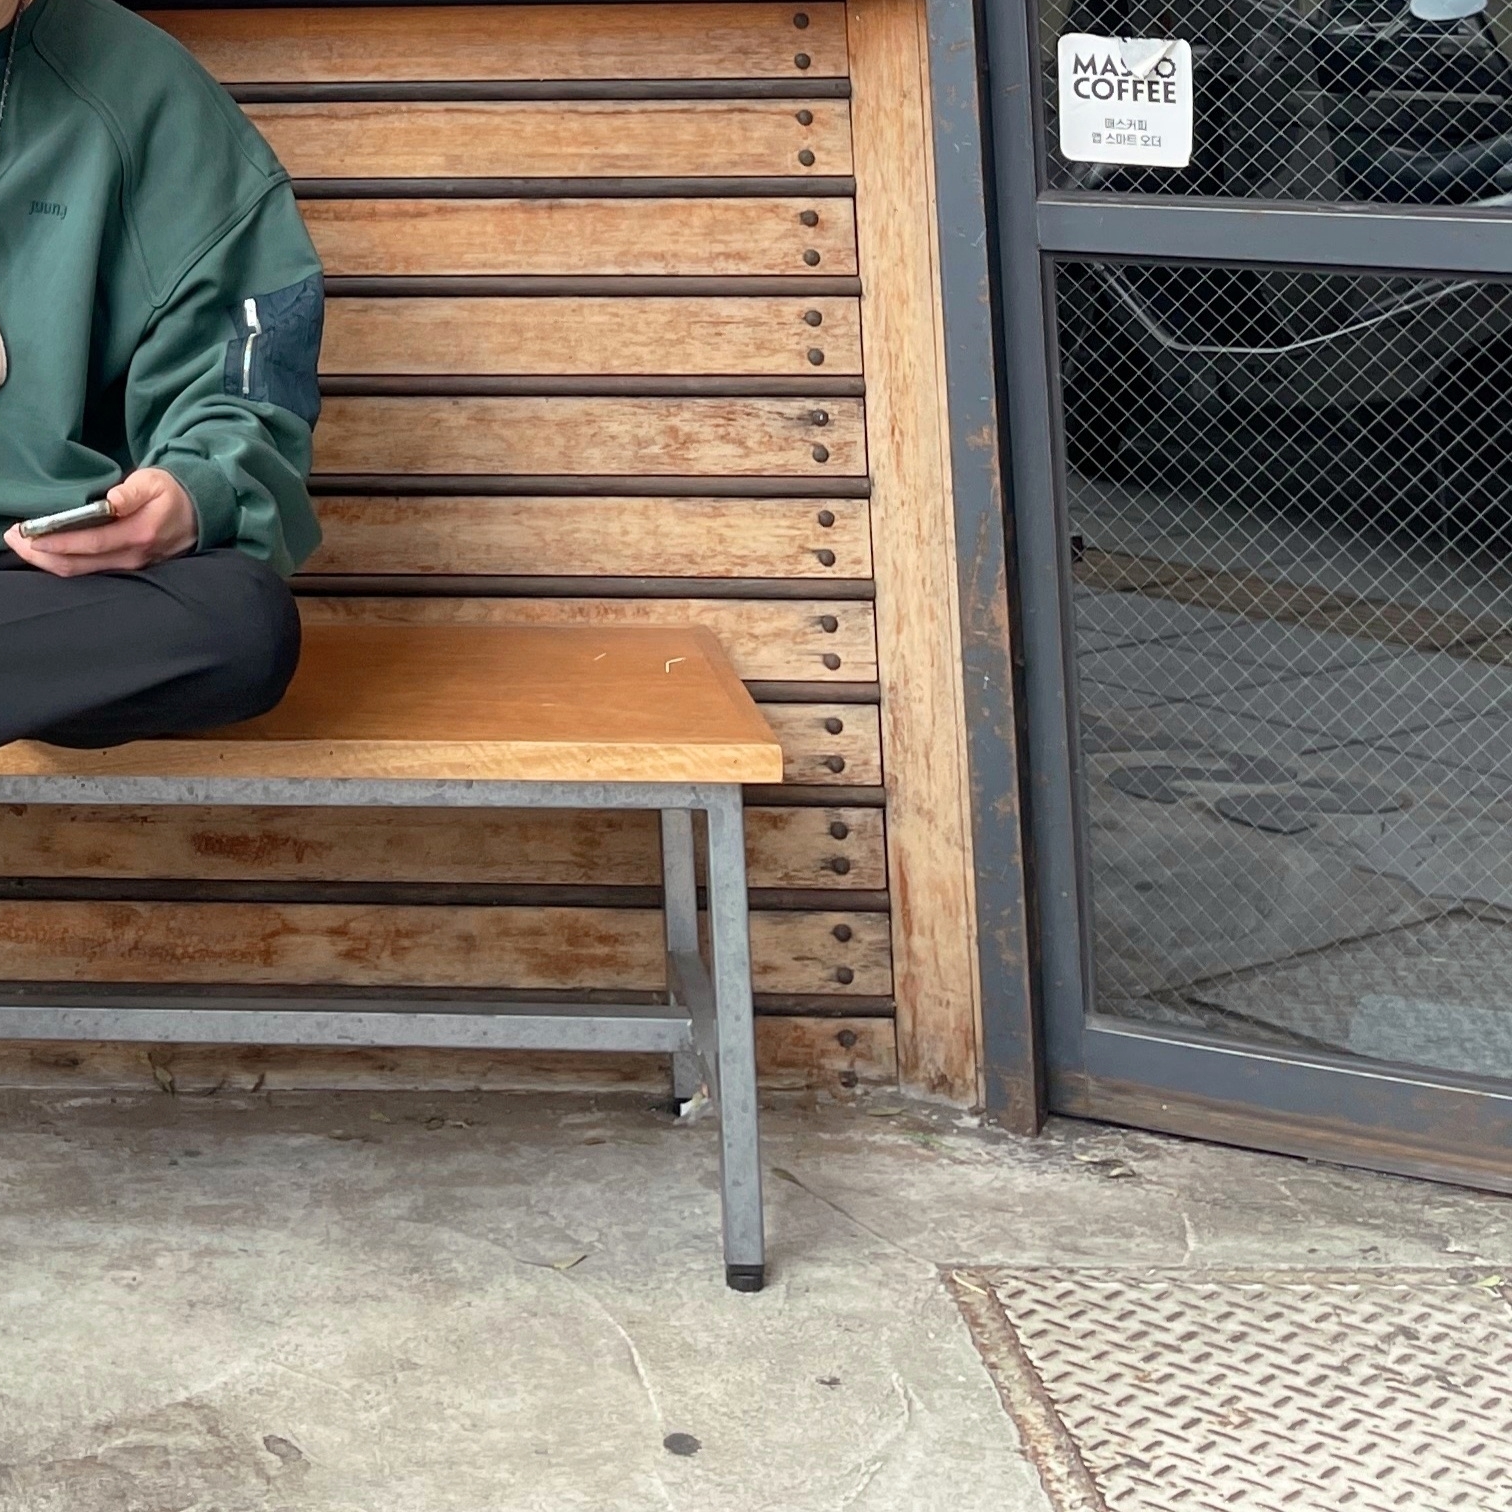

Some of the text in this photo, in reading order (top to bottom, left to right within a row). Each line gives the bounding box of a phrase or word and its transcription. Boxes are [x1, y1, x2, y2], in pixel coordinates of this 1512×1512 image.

[1073, 52, 1134, 77] MAS
[1073, 77, 1177, 104] COFFEE
[1092, 132, 1162, 147] 앱 스마트 오더
